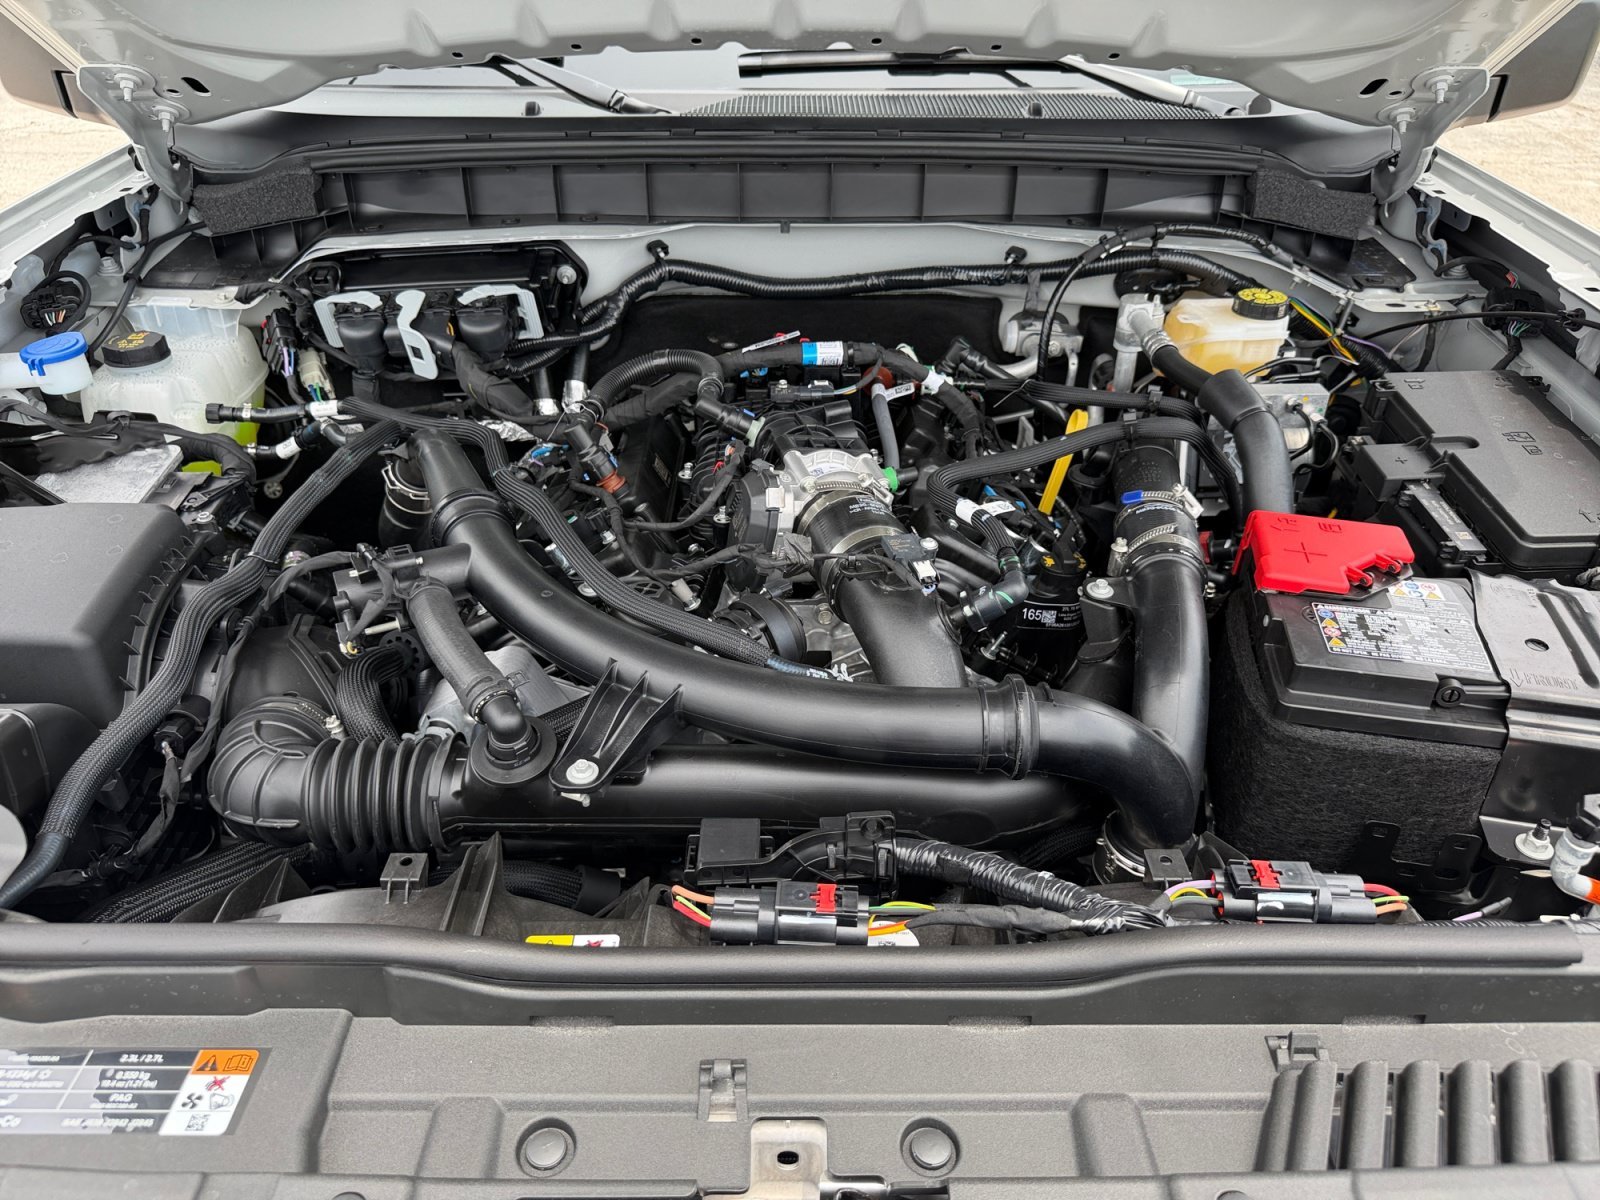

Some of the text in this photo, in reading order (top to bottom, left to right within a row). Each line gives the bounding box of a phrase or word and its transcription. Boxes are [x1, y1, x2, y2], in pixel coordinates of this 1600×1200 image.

[1022, 608, 1042, 620] 165
[1524, 671, 1578, 690] FRONT
[109, 1093, 133, 1103] PAG
